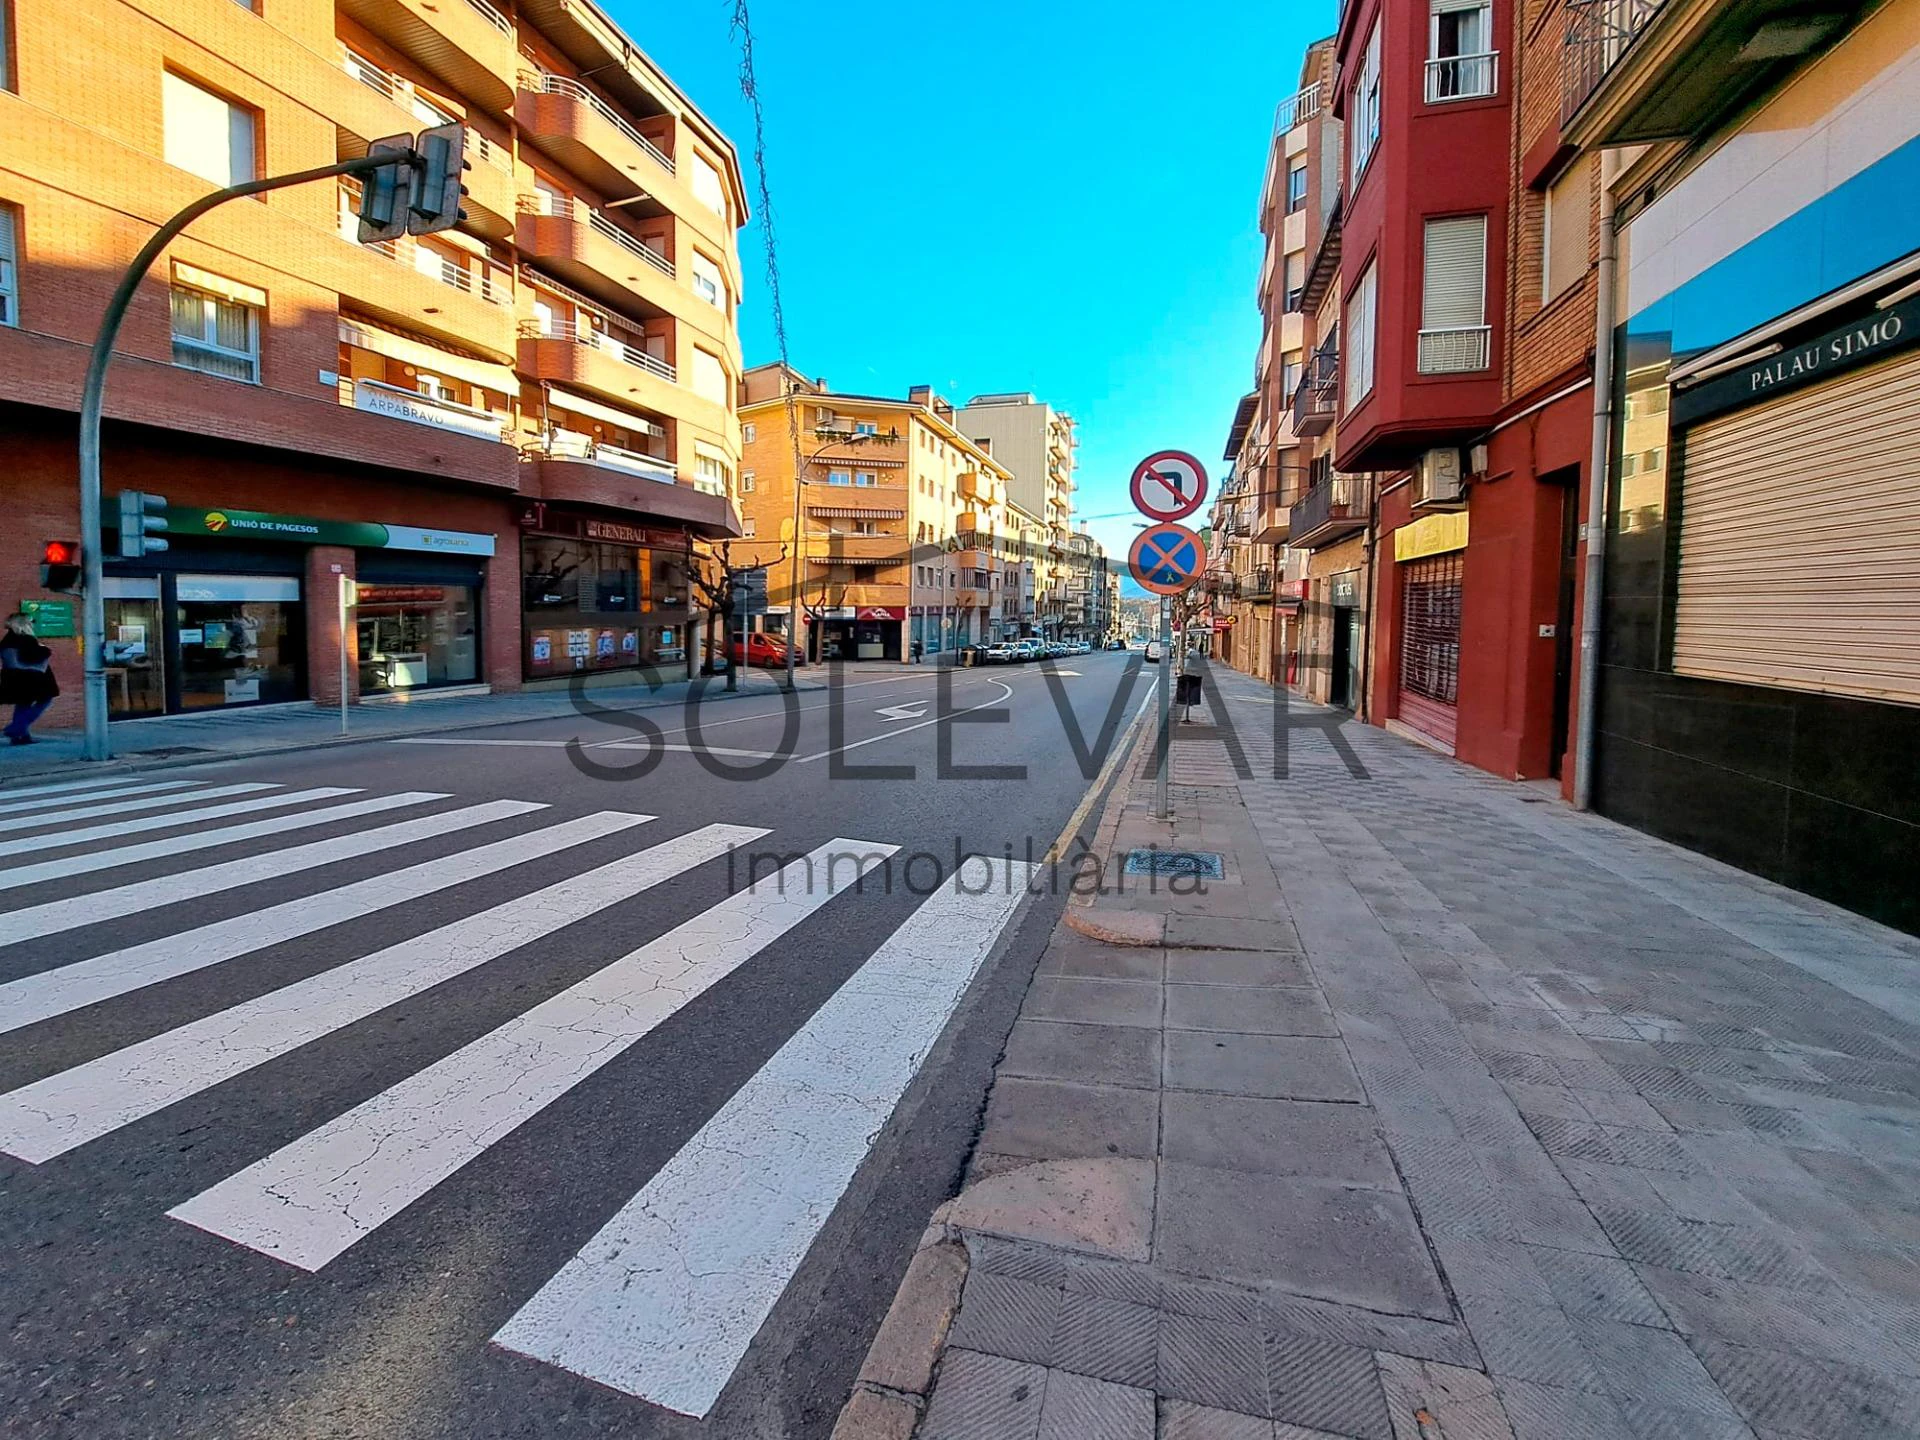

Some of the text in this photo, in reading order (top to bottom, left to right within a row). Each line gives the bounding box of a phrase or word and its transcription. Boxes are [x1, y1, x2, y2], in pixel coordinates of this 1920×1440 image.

[1750, 311, 1902, 391] PALAU SIMÓ
[368, 398, 444, 425] ARPABRAVO
[231, 519, 319, 533] UNIÓ DE PAGESOS
[598, 523, 646, 542] GENERALI
